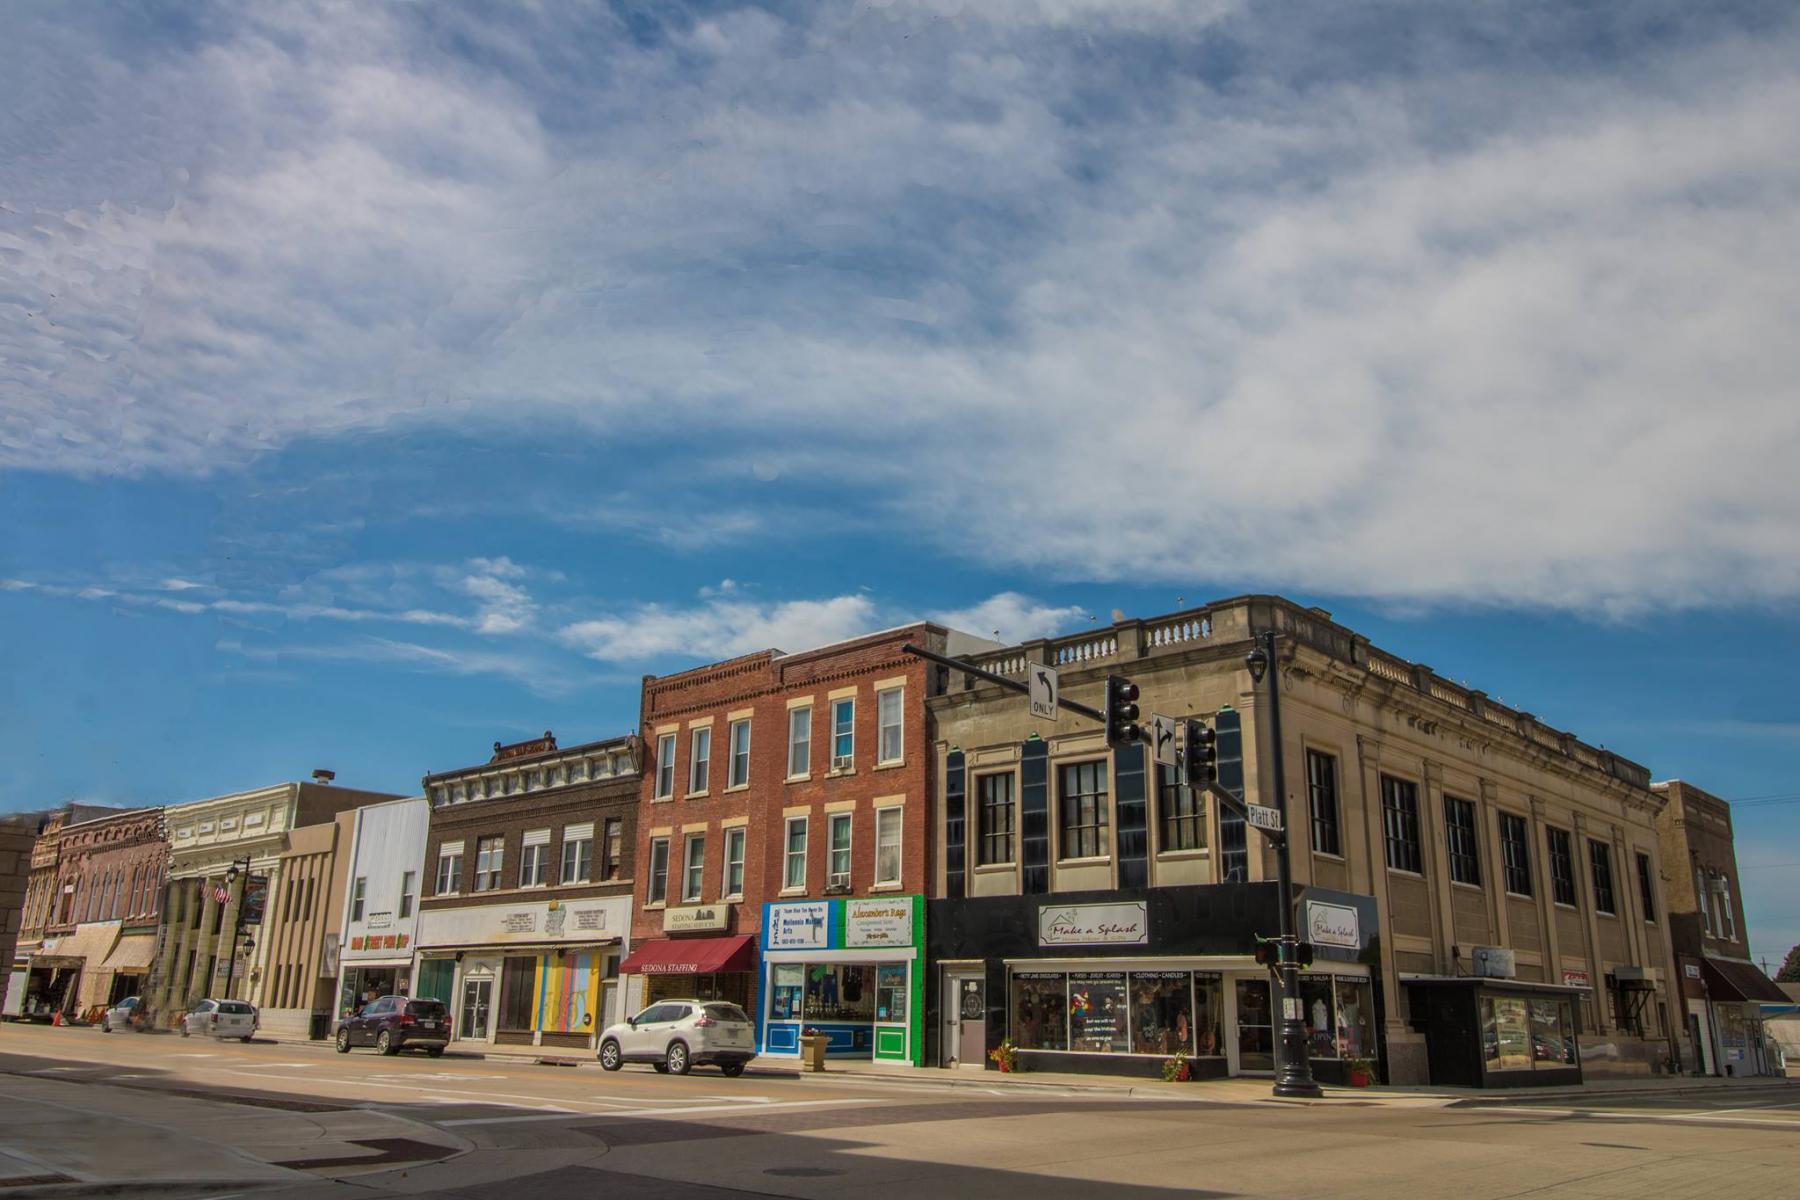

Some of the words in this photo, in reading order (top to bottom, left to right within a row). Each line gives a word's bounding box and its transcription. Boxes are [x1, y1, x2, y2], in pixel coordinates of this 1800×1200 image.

[1033, 701, 1053, 717] ONLY
[1250, 806, 1269, 826] Platt
[1270, 810, 1279, 829] St
[672, 913, 694, 922] SEDONA
[1053, 925, 1082, 935] Make
[1098, 923, 1137, 936] Splash
[1316, 923, 1331, 934] Make
[641, 964, 666, 973] SEDONA
[667, 963, 698, 972] STAFFING
